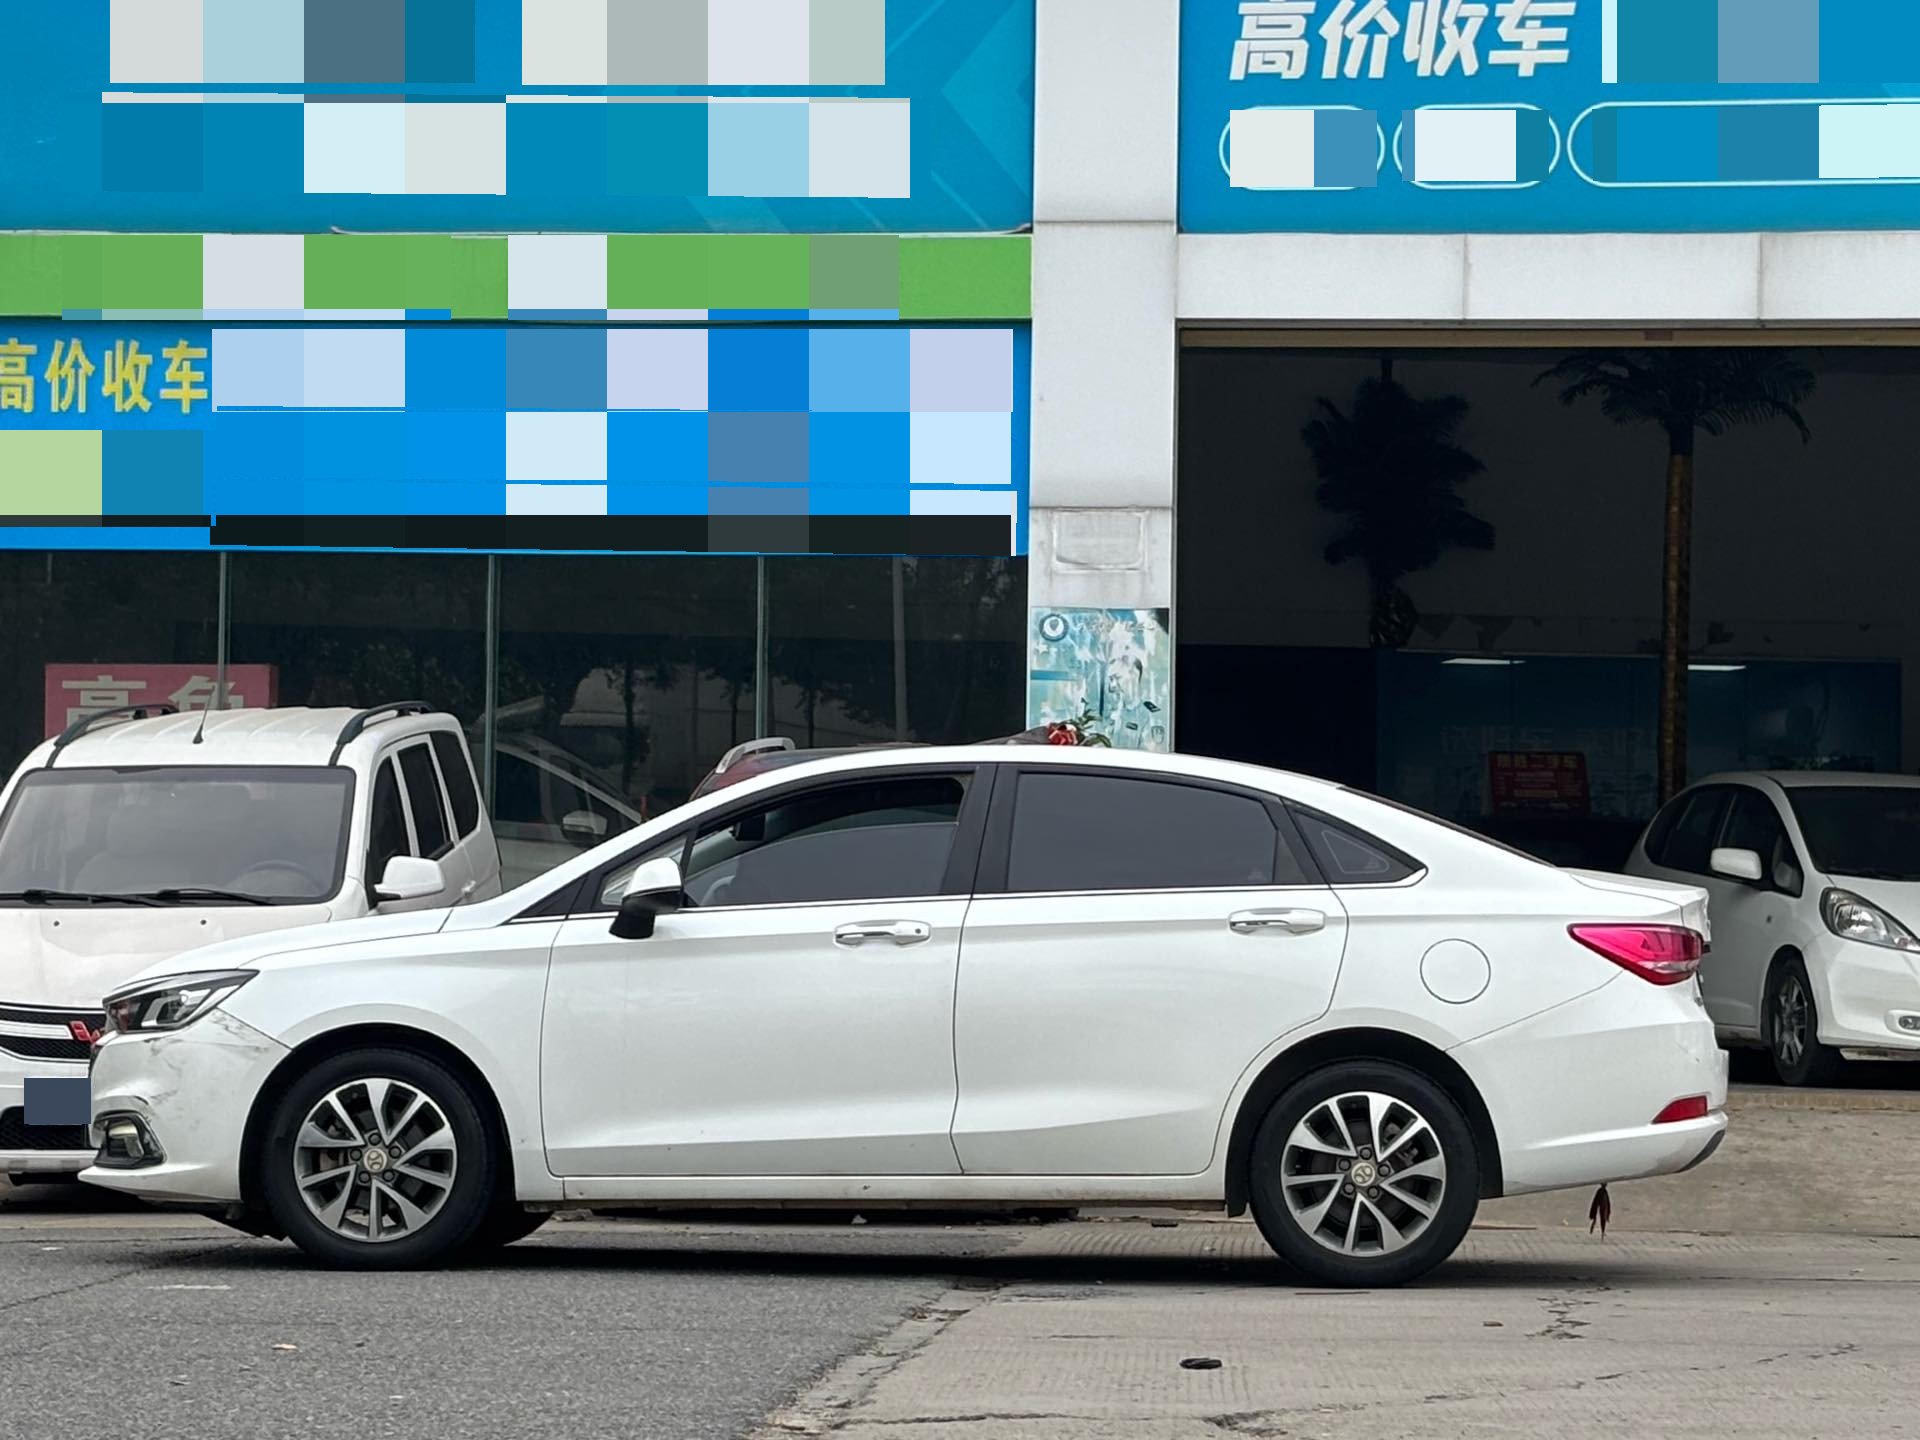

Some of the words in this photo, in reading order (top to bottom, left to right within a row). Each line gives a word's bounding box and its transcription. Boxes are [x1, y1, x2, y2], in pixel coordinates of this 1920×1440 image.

[1229, 0, 1577, 81] 高价收车
[0, 337, 208, 414] 高价收车
